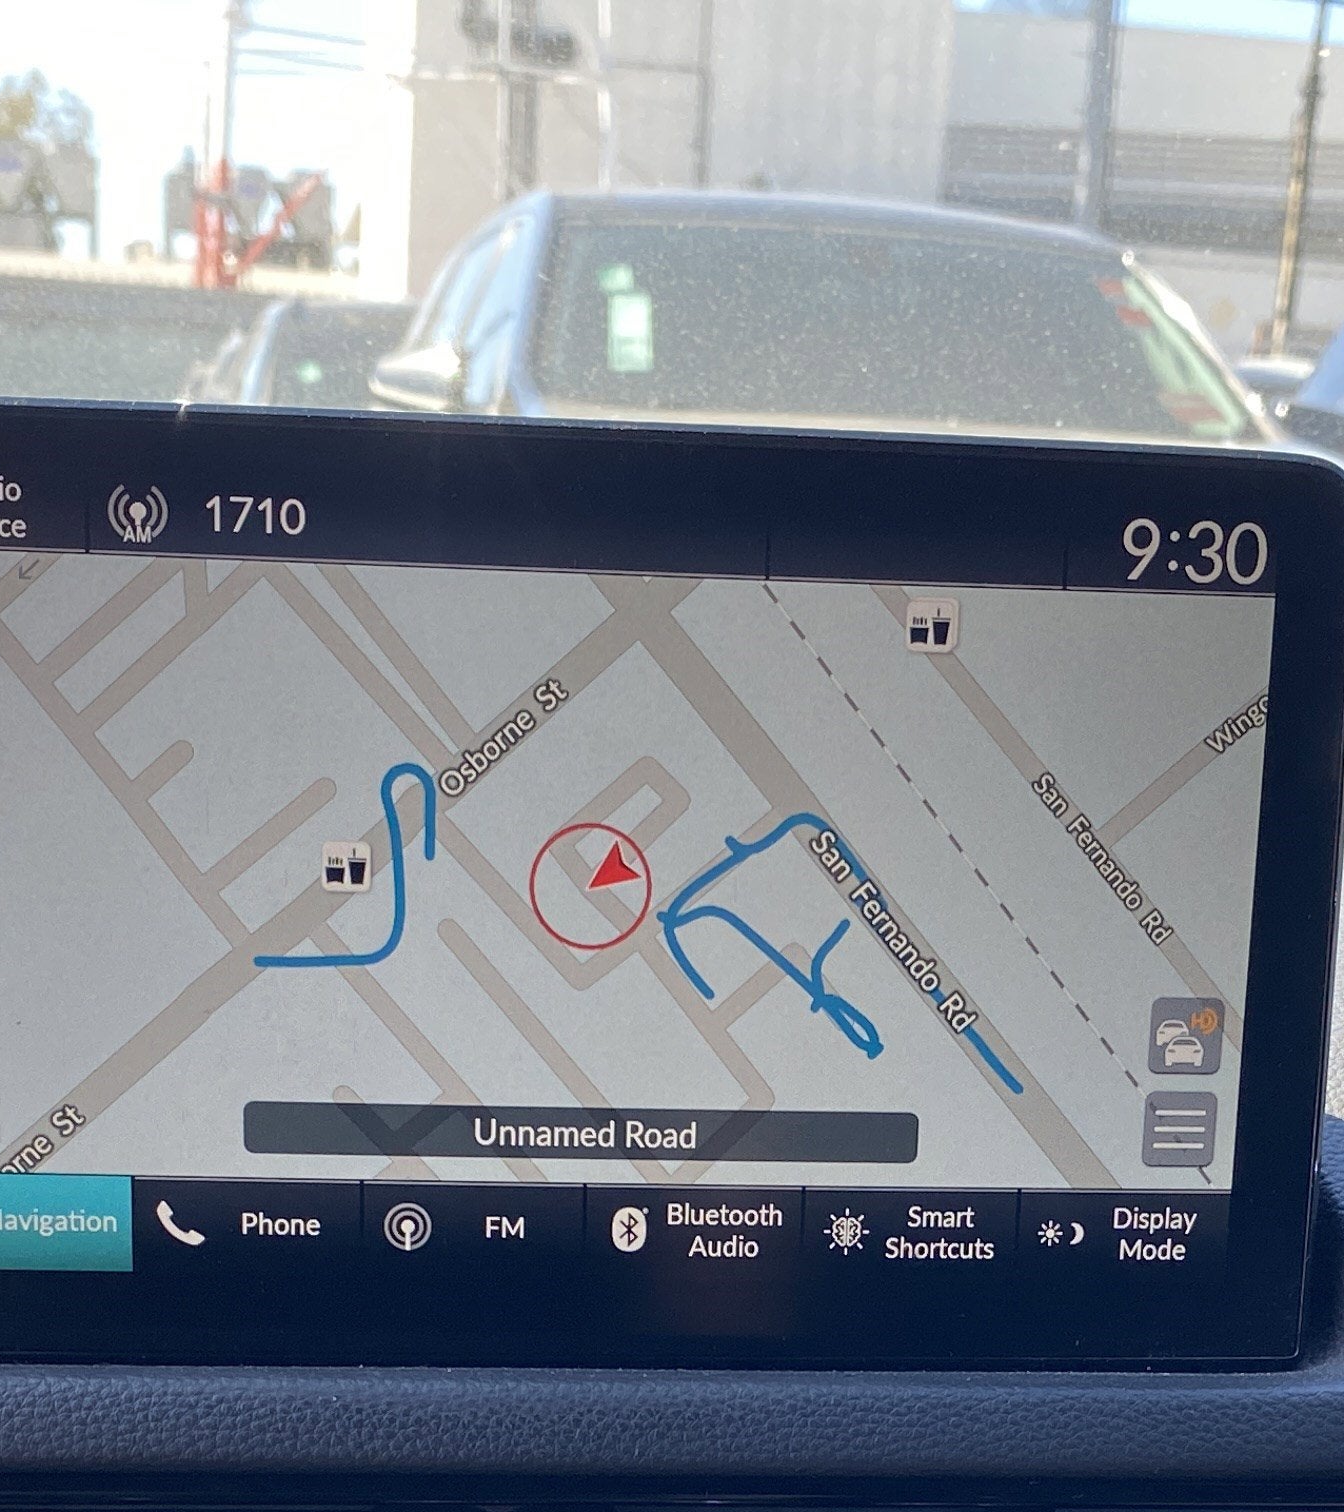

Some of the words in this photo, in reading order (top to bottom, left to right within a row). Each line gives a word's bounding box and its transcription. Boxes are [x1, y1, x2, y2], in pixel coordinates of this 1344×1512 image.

[205, 495, 306, 536] 1710
[123, 526, 152, 543] AM
[1123, 518, 1268, 585] 9:30
[440, 711, 535, 796] Osborne
[536, 680, 567, 711] St
[1033, 774, 1068, 816] San
[1068, 815, 1141, 909] Fernando
[1141, 909, 1173, 944] Rd
[811, 831, 850, 881] San
[851, 881, 938, 991] Fernando
[939, 993, 976, 1032] Rd
[52, 1106, 85, 1135] St
[474, 1117, 616, 1148] Unnamed
[625, 1120, 697, 1149] Road
[241, 1211, 321, 1236] Phone
[485, 1216, 525, 1239] FM
[667, 1202, 783, 1227] Bluetooth
[907, 1205, 975, 1228] Smart
[1113, 1206, 1198, 1235] Display
[688, 1234, 759, 1258] Audio
[885, 1235, 995, 1260] Shortcuts
[1119, 1238, 1186, 1261] Mode
